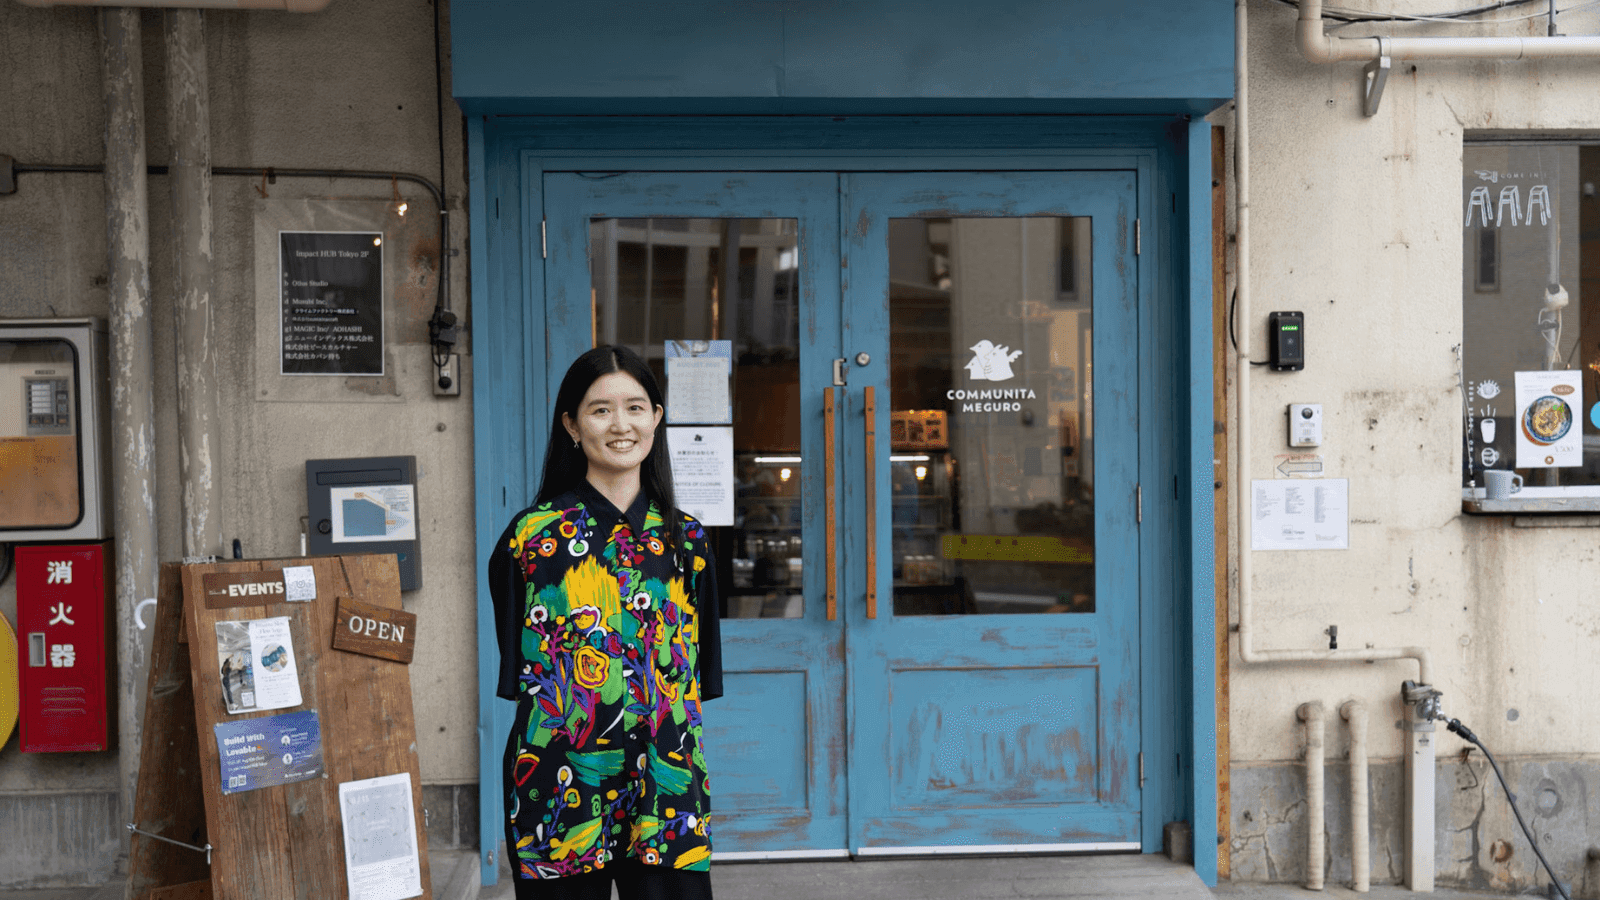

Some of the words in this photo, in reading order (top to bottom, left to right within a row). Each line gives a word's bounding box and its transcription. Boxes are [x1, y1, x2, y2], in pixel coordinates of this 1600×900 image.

[296, 250, 319, 258] Impact
[338, 250, 359, 258] Tokyo
[946, 389, 1036, 400] COMMUNITA
[962, 402, 1021, 412] MEGURO
[228, 581, 284, 597] EVENTS
[47, 560, 76, 668] 消火器
[349, 615, 405, 644] OPEN
[224, 735, 245, 746] Build
[226, 745, 256, 757] Lovable
